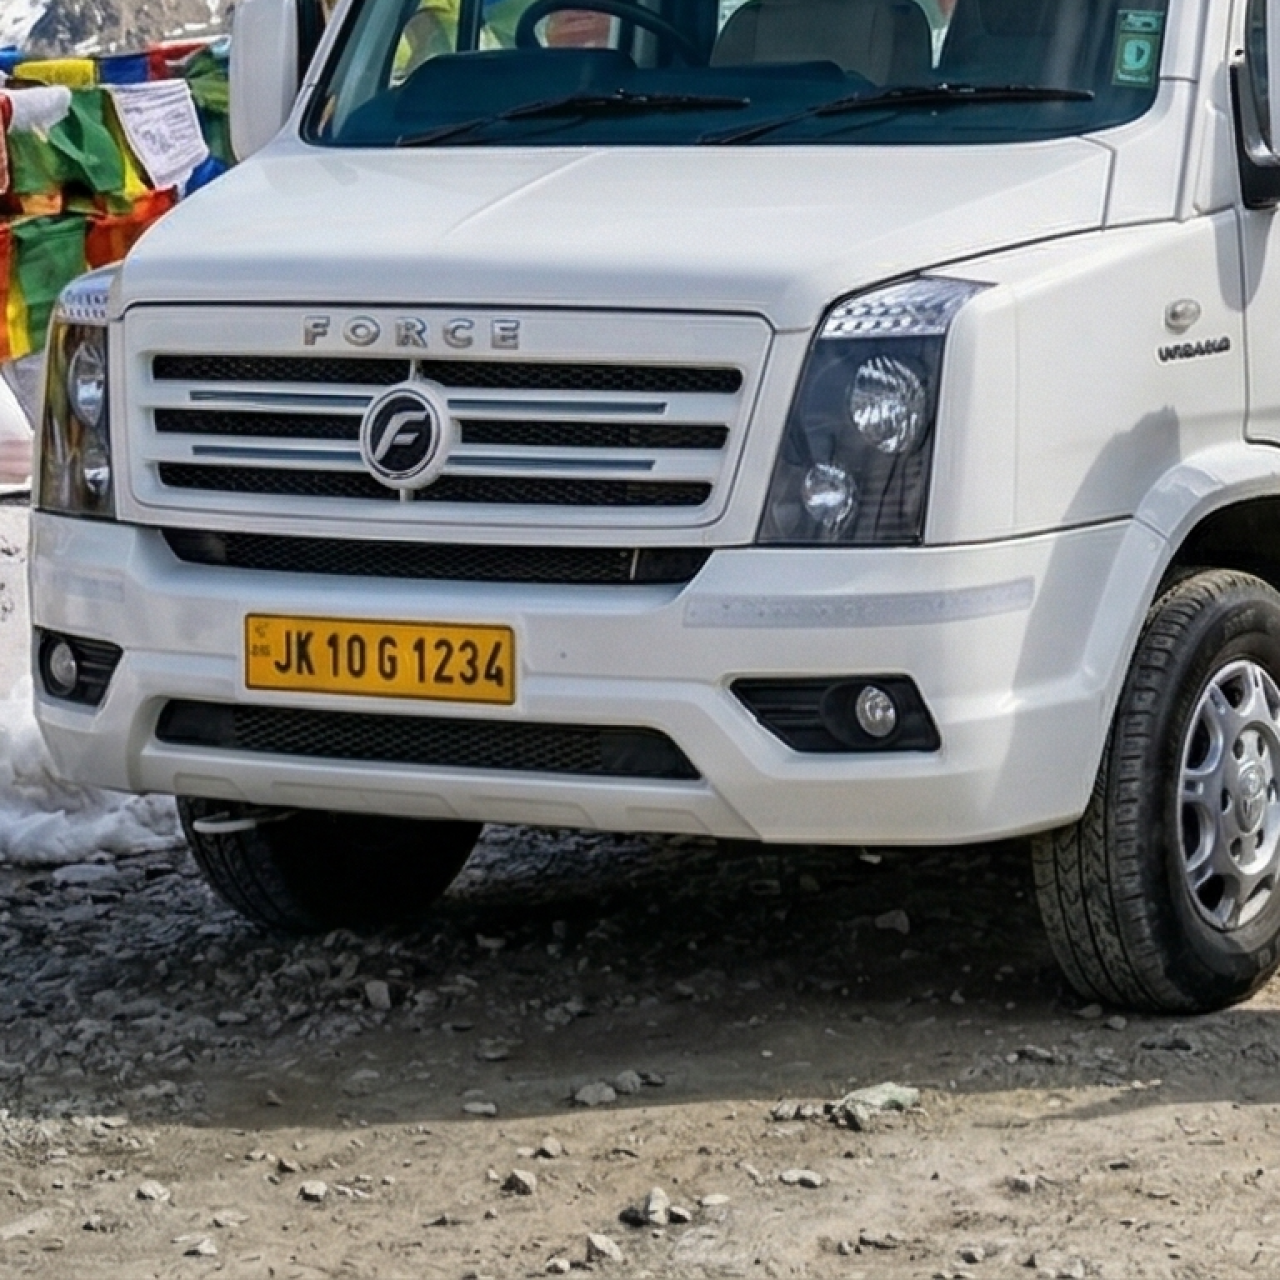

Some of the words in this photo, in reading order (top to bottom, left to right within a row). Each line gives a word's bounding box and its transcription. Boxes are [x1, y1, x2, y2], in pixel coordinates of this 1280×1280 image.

[303, 314, 521, 350] FORCE
[274, 630, 316, 676] JK
[326, 632, 366, 679] 10
[377, 635, 398, 681] G
[412, 637, 505, 688] 1234
